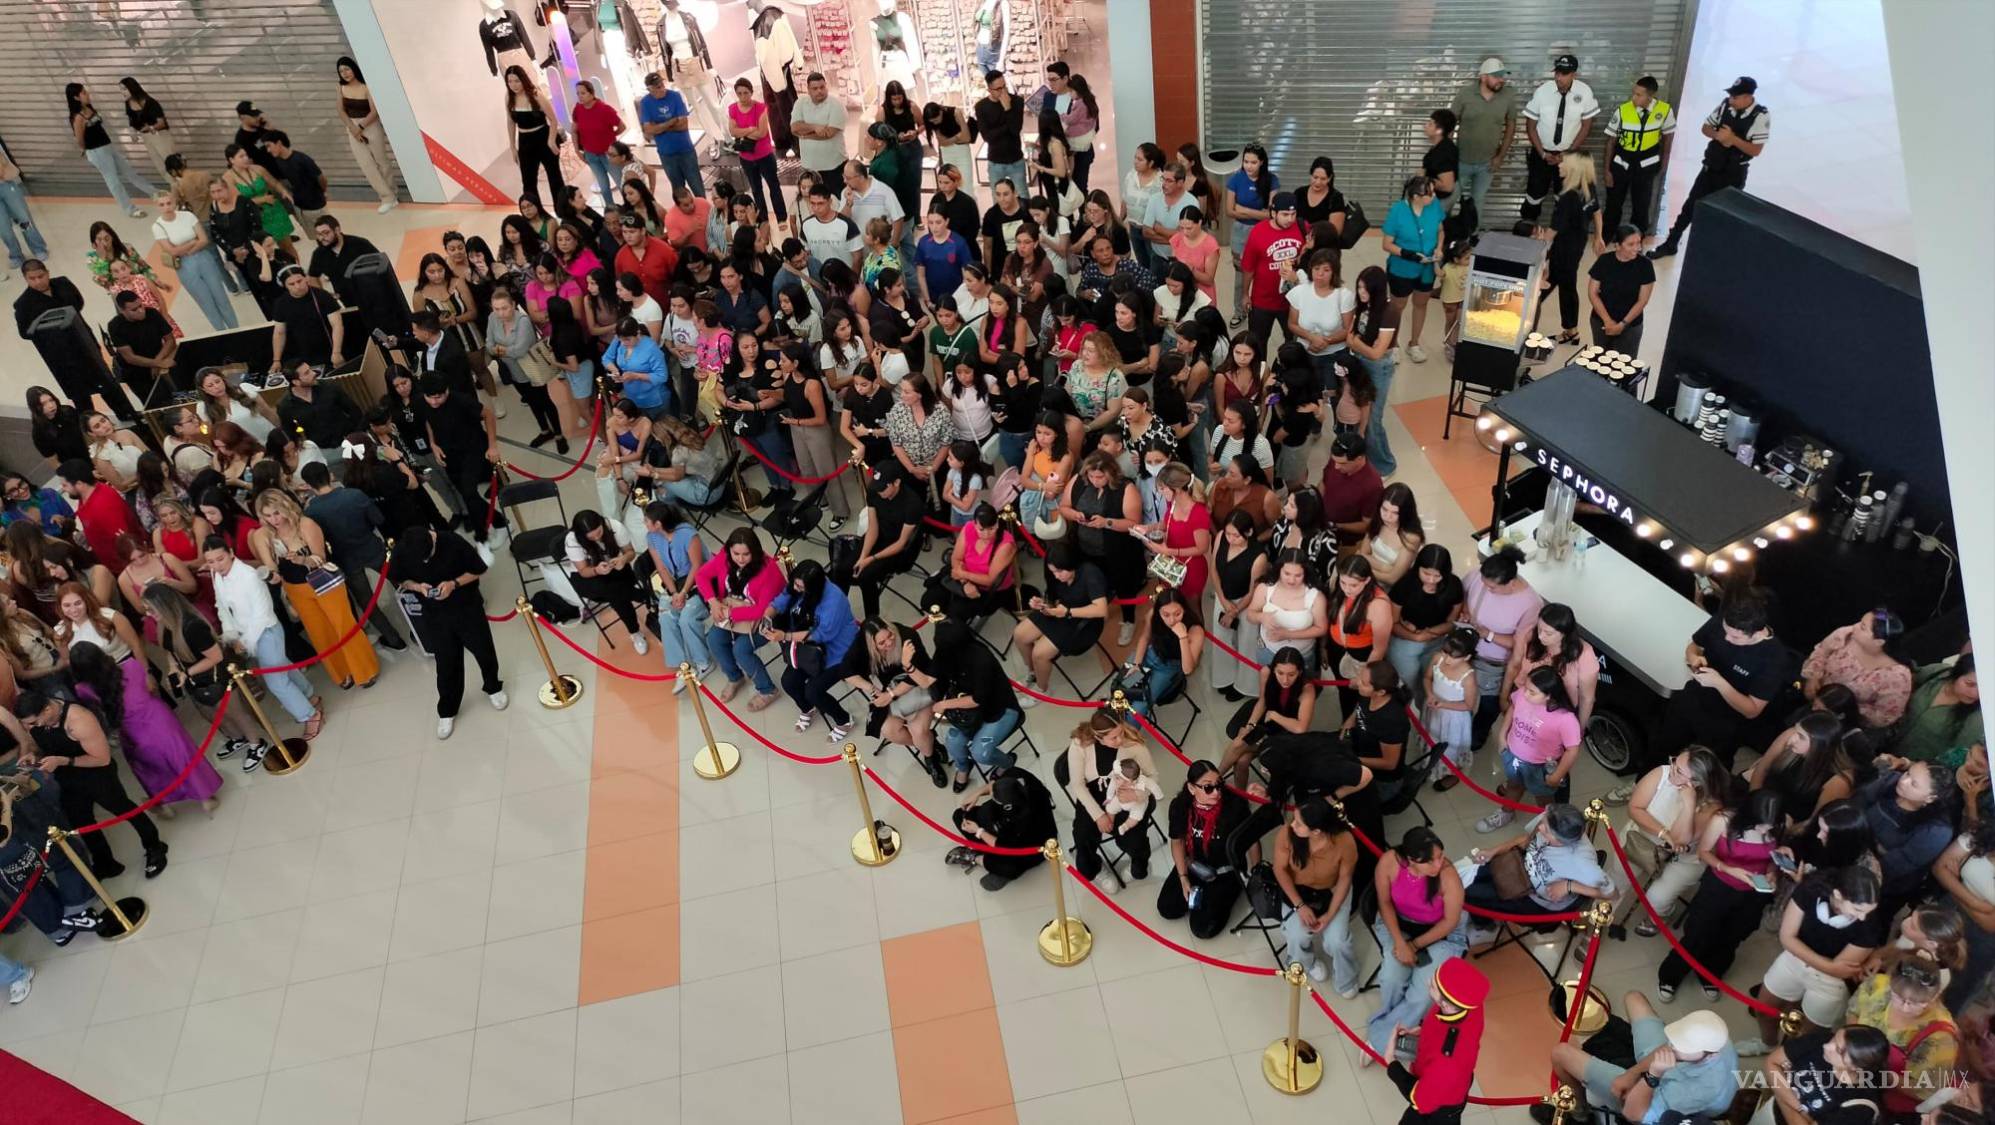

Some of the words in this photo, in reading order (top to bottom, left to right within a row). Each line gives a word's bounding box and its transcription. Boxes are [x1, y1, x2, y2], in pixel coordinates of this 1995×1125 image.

[1266, 238, 1302, 257] SCOTT
[1537, 448, 1634, 525] SEPHORA
[1732, 664, 1750, 677] STAFF
